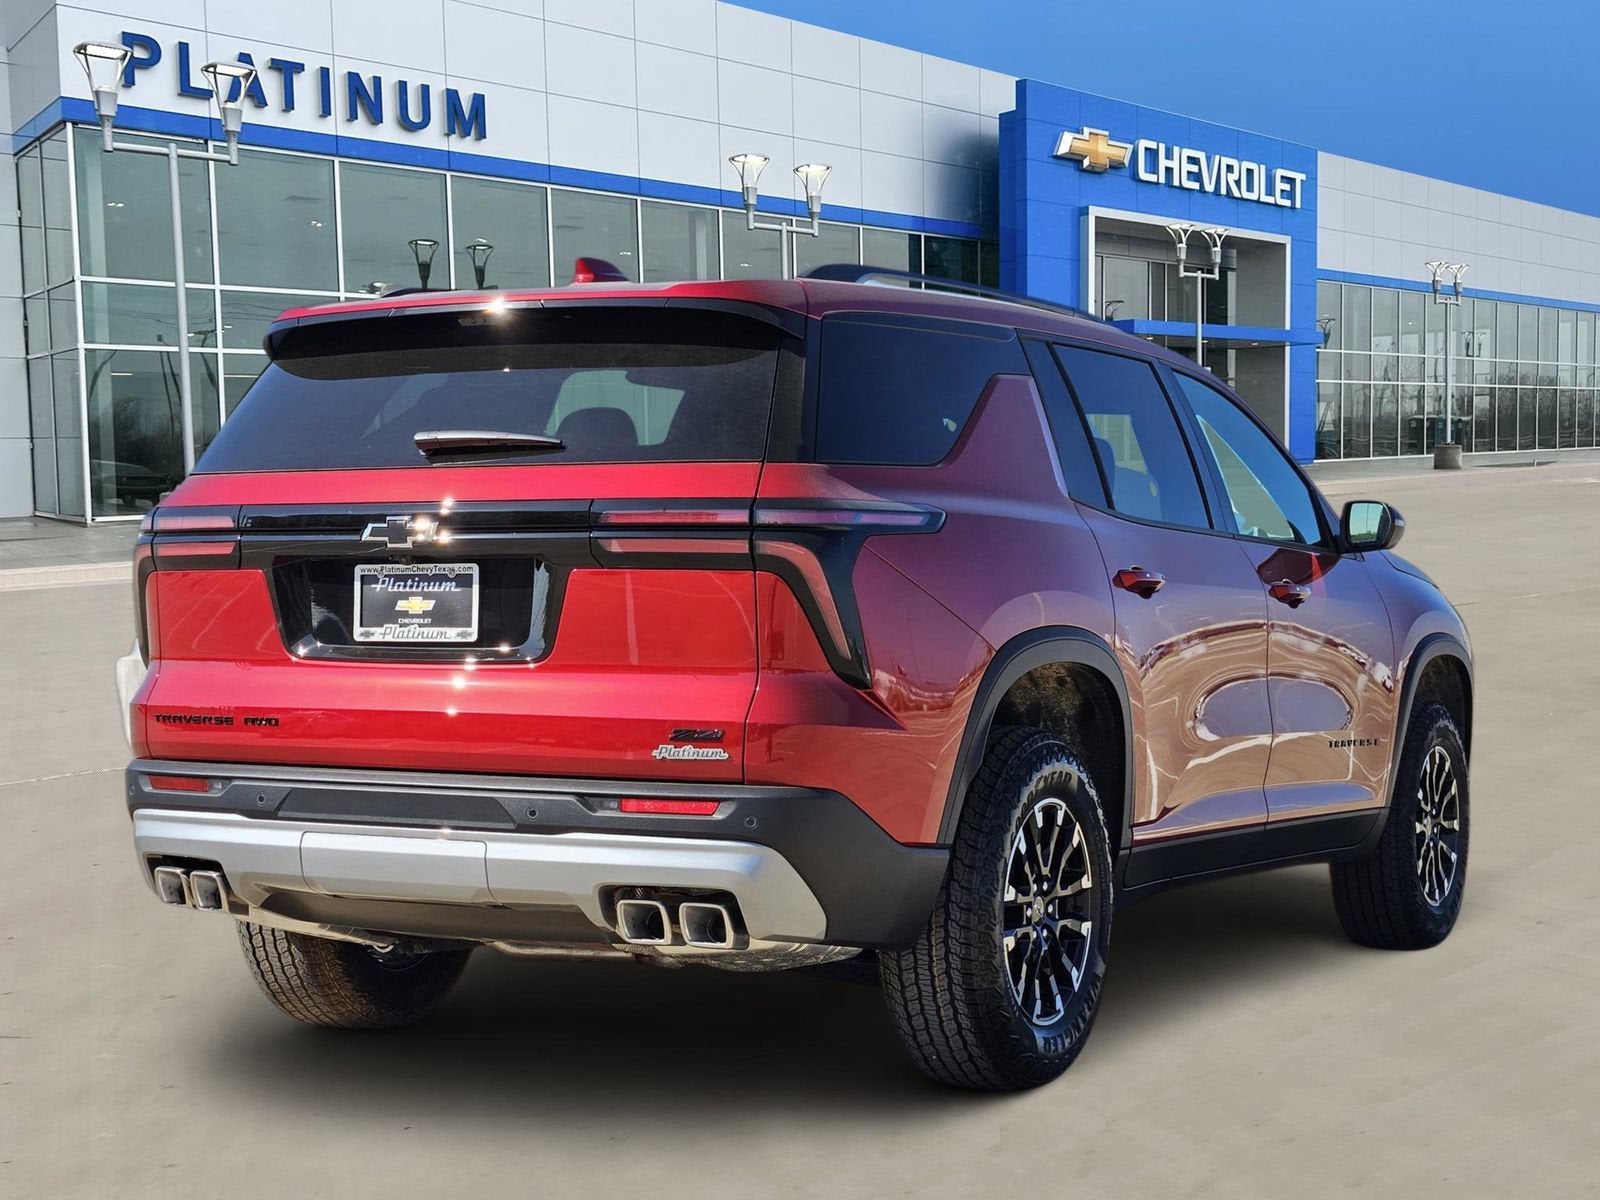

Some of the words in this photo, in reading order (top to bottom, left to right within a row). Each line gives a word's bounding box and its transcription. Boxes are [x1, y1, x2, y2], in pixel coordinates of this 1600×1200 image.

[121, 30, 487, 141] PLATINUM
[1137, 138, 1306, 209] CHEVROLET
[371, 577, 461, 592] Platinum
[379, 626, 451, 640] Platinum
[155, 714, 234, 726] TRAVERSE
[243, 716, 279, 728] AWD
[1328, 738, 1378, 749] TRAVERSE
[652, 745, 729, 760] Platinum
